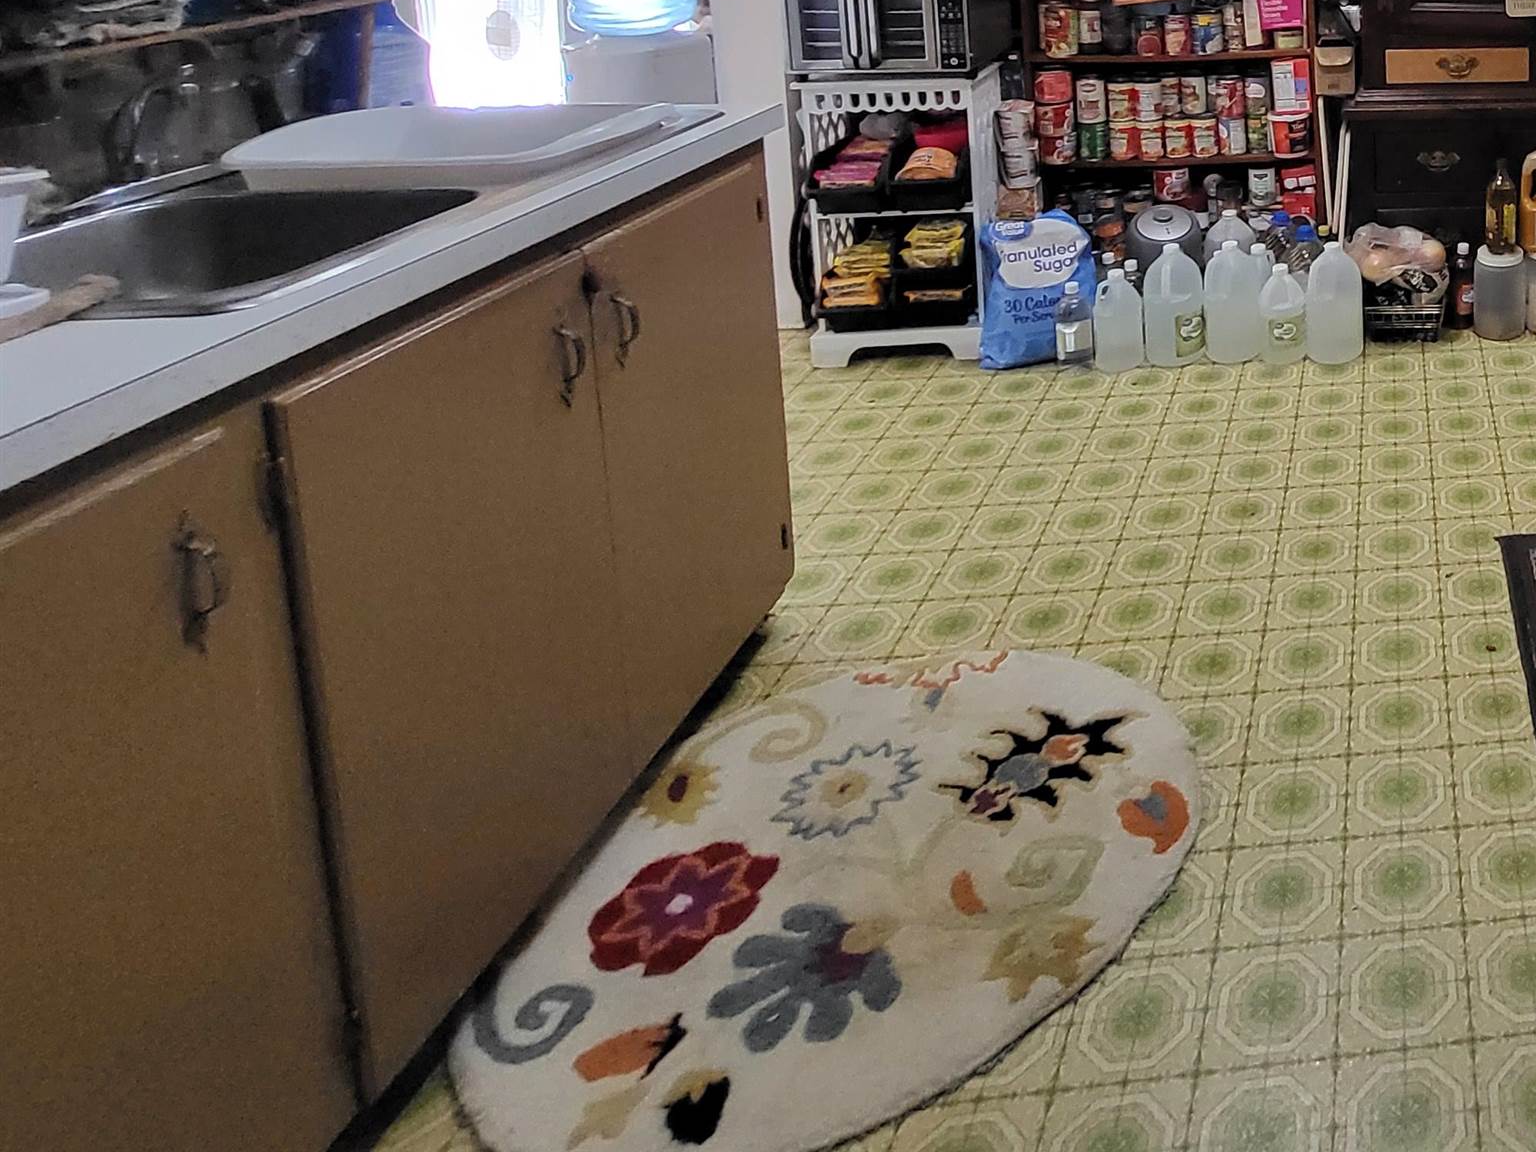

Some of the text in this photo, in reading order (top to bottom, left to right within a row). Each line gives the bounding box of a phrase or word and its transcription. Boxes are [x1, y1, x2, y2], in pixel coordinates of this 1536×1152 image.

[994, 221, 1025, 232] Great
[1001, 241, 1078, 263] ranulated
[1004, 298, 1022, 314] 30
[1012, 314, 1031, 325] Per
